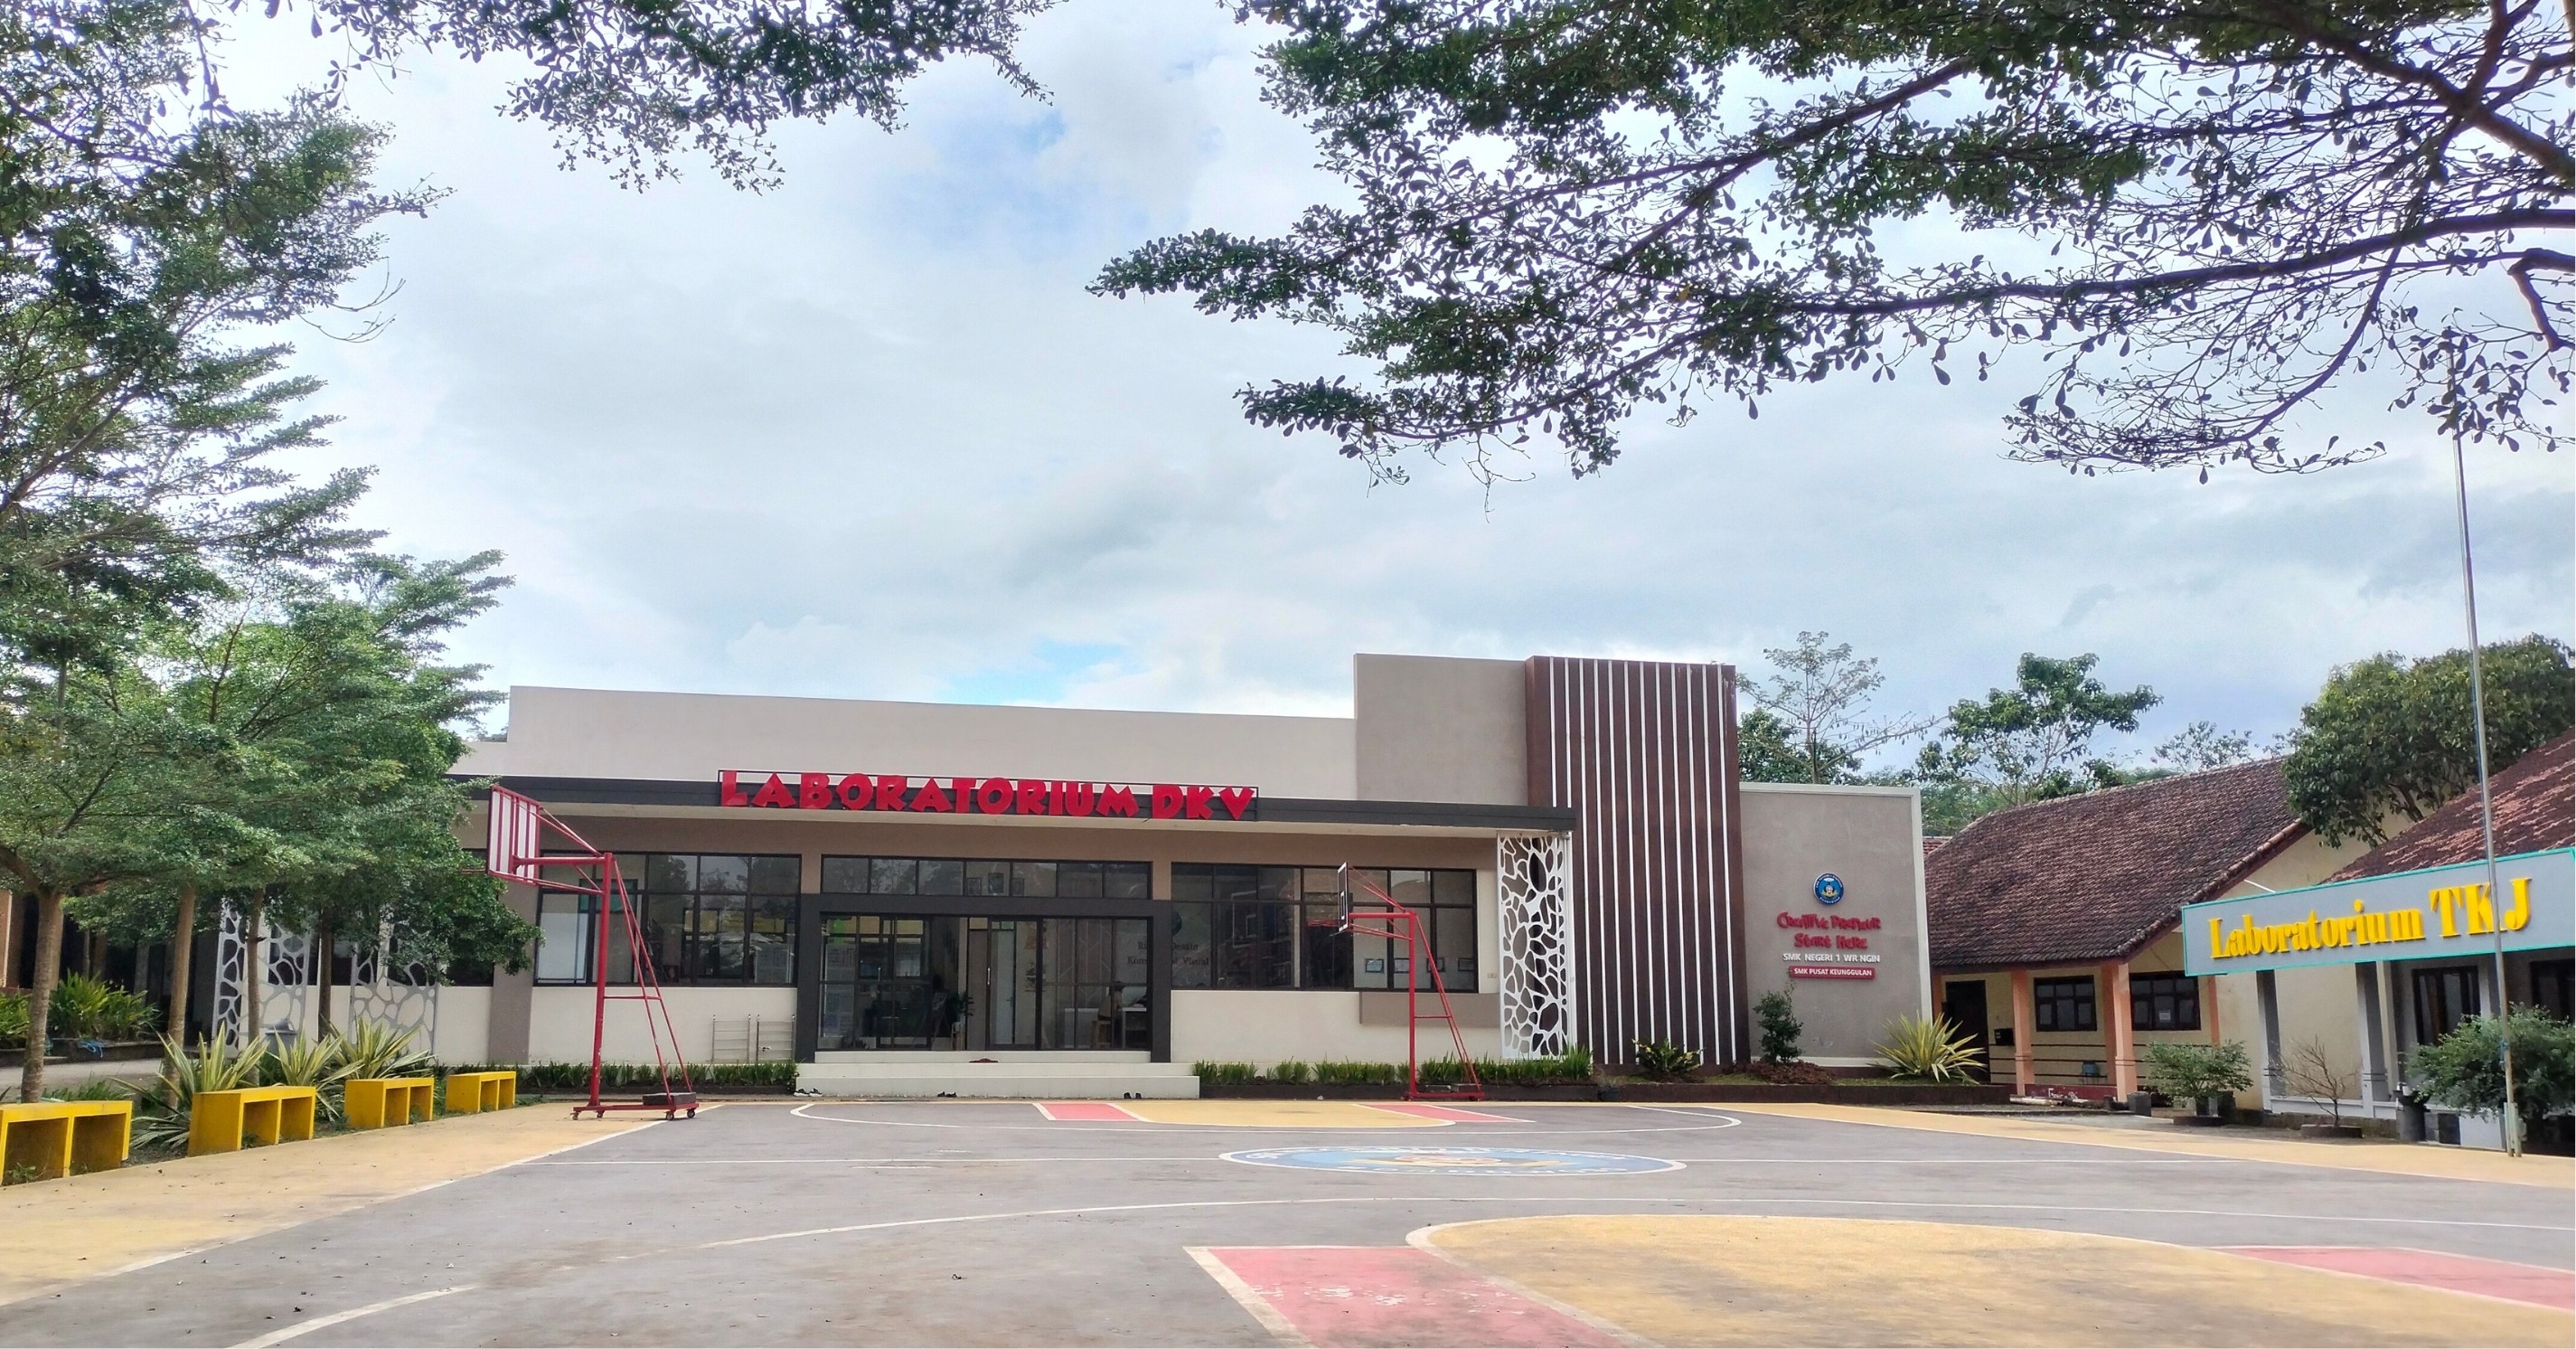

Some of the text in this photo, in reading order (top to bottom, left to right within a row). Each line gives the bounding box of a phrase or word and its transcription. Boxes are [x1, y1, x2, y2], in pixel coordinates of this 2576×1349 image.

[721, 770, 1255, 820] LABORATORIUM DKV
[2208, 877, 2532, 959] Laboratorium TKJ
[1782, 953, 1801, 961] SMK
[1804, 954, 1833, 962] NEGERI
